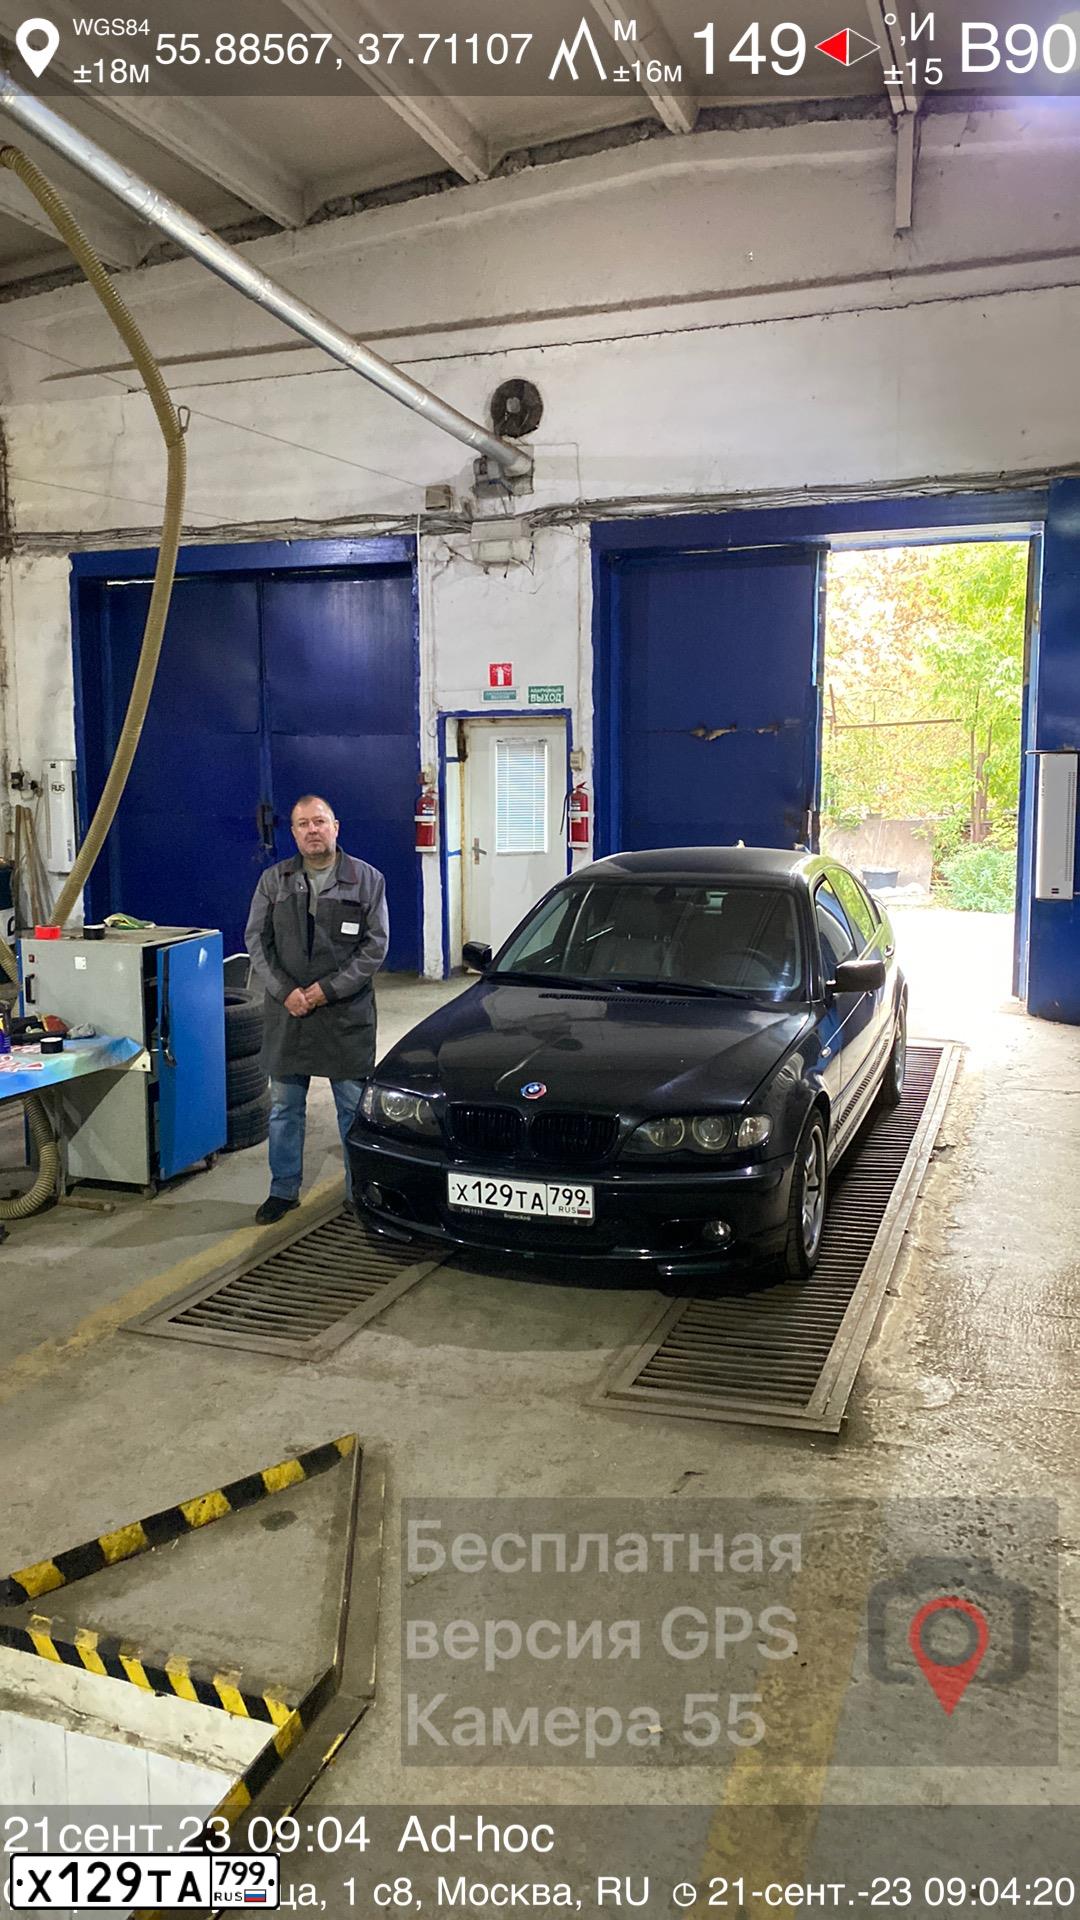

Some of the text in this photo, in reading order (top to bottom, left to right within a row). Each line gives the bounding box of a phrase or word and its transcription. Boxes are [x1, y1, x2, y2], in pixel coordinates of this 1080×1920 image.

[530, 693, 562, 702] ВЫХОД
[51, 784, 65, 792] RUS
[456, 1180, 586, 1211] Х129ТА 799
[558, 1206, 577, 1214] RUS
